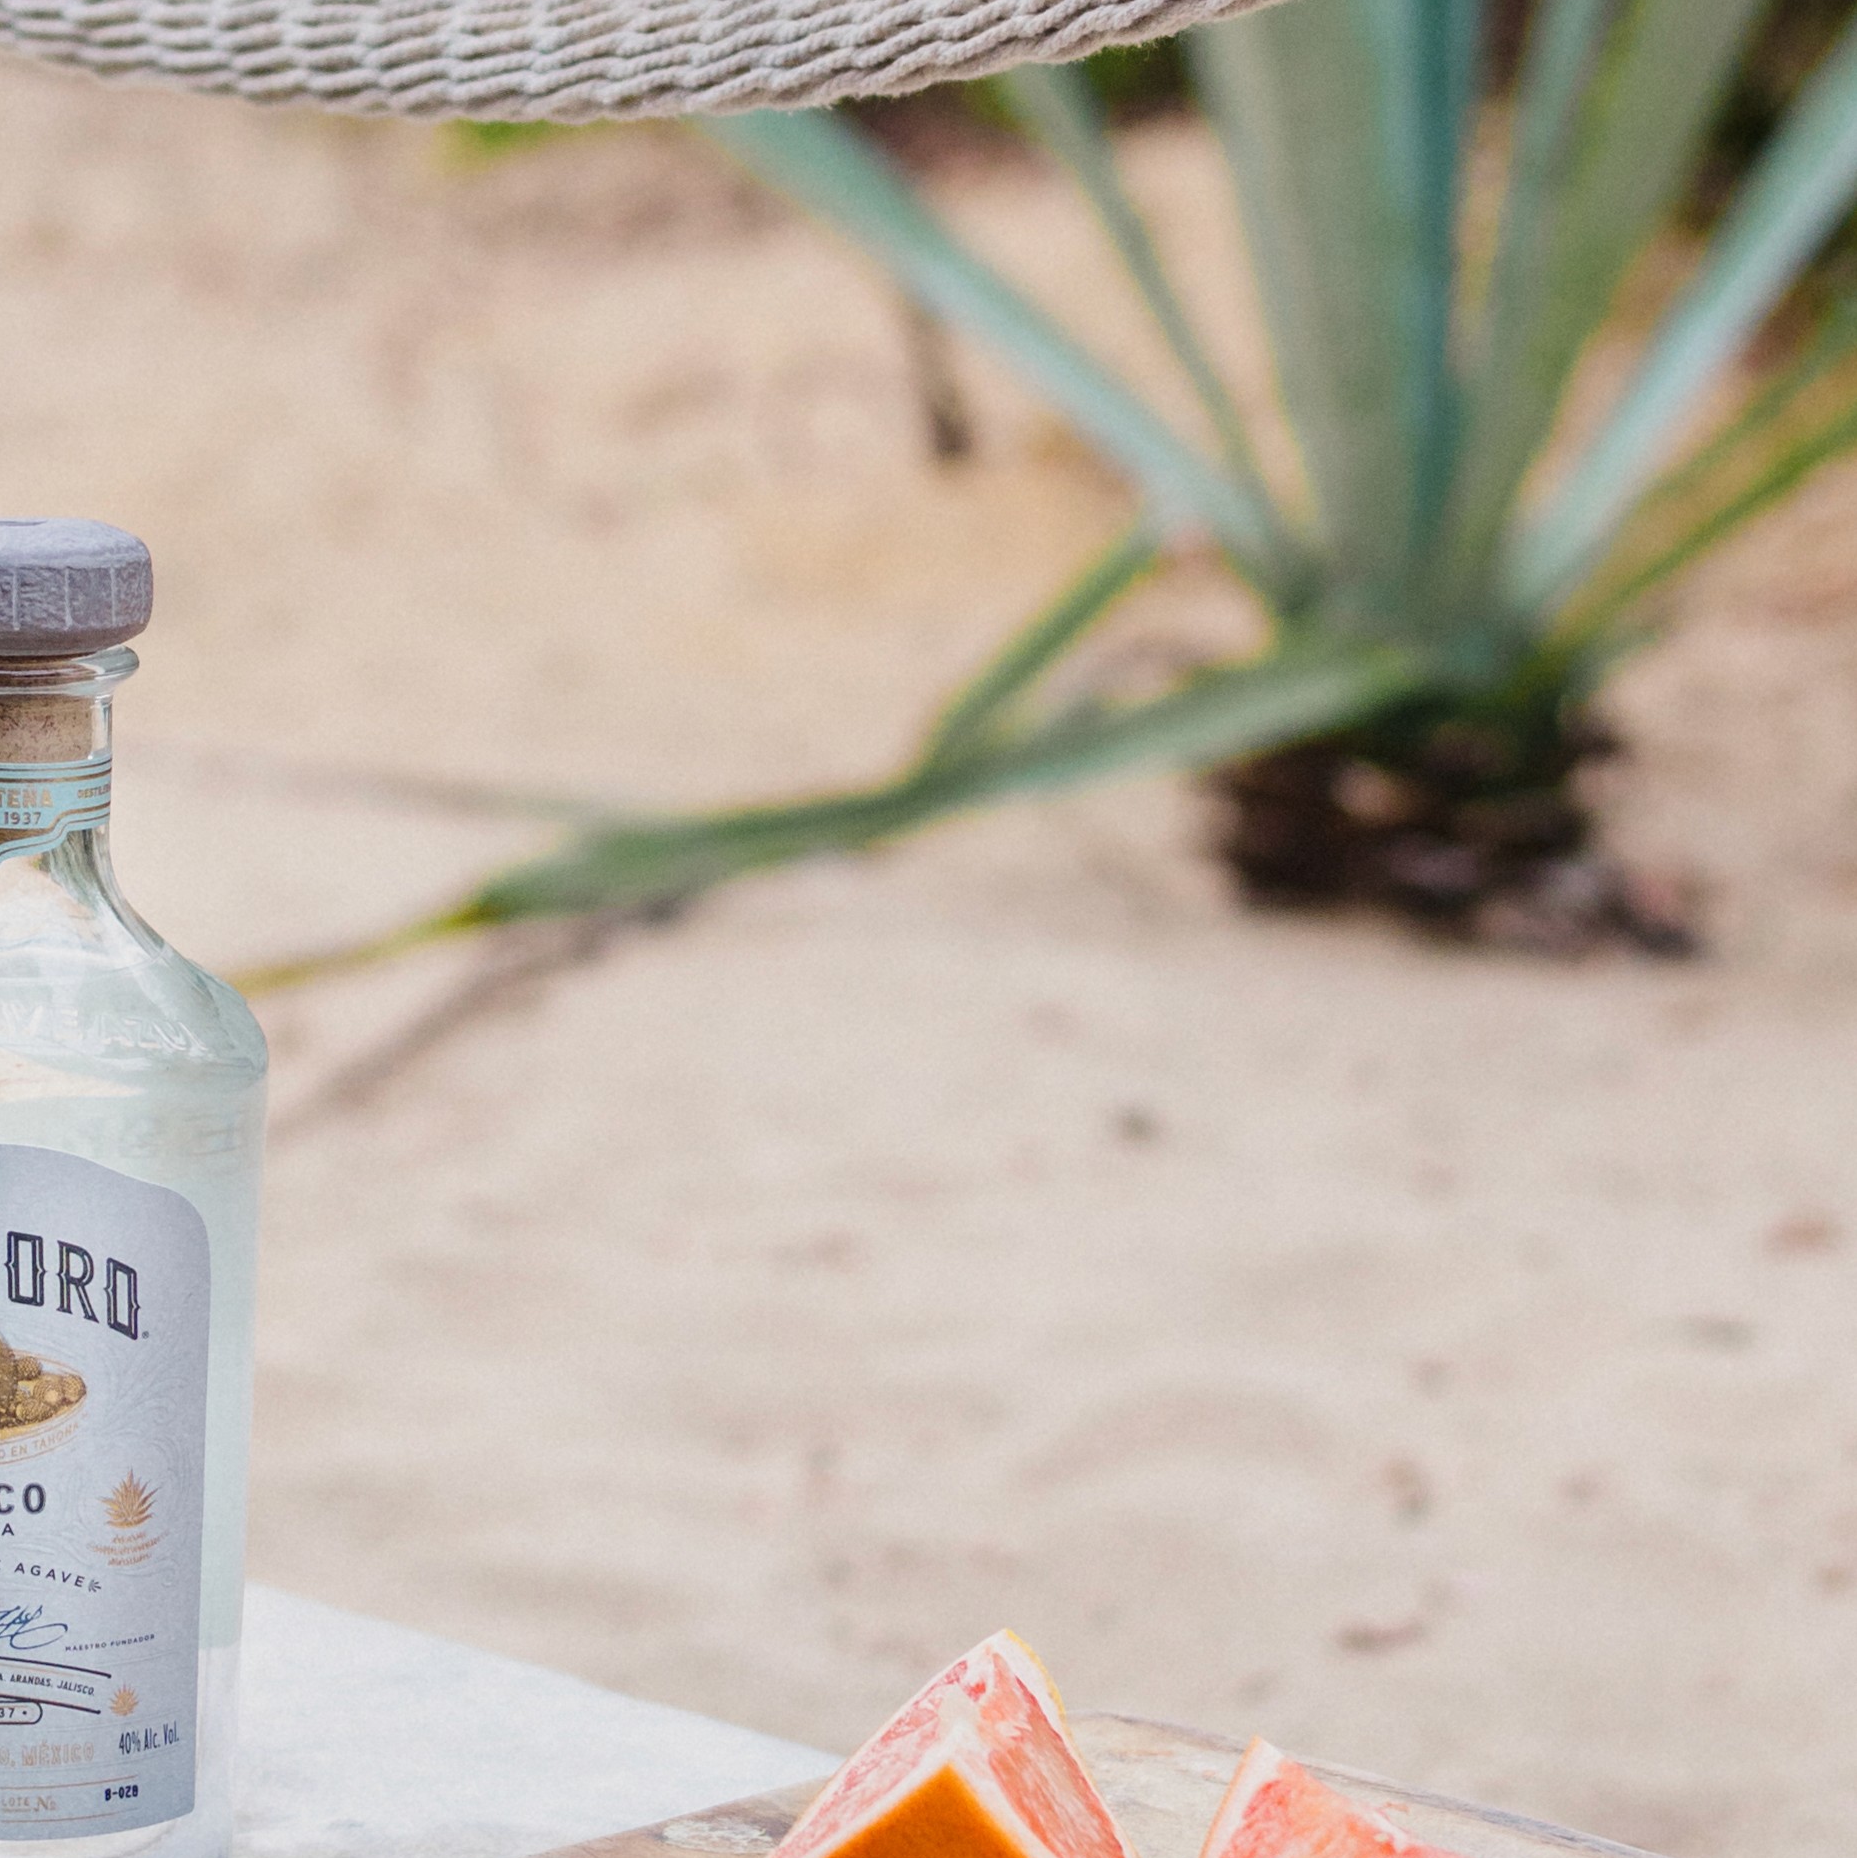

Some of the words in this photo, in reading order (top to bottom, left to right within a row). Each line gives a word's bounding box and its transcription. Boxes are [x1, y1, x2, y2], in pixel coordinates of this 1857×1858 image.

[4, 811, 42, 825] 1937
[11, 1445, 28, 1457] EN
[14, 1562, 86, 1588] AGAVE
[119, 1730, 141, 1755] 40%
[143, 1727, 161, 1751] Alc.
[163, 1719, 180, 1745] Vol.
